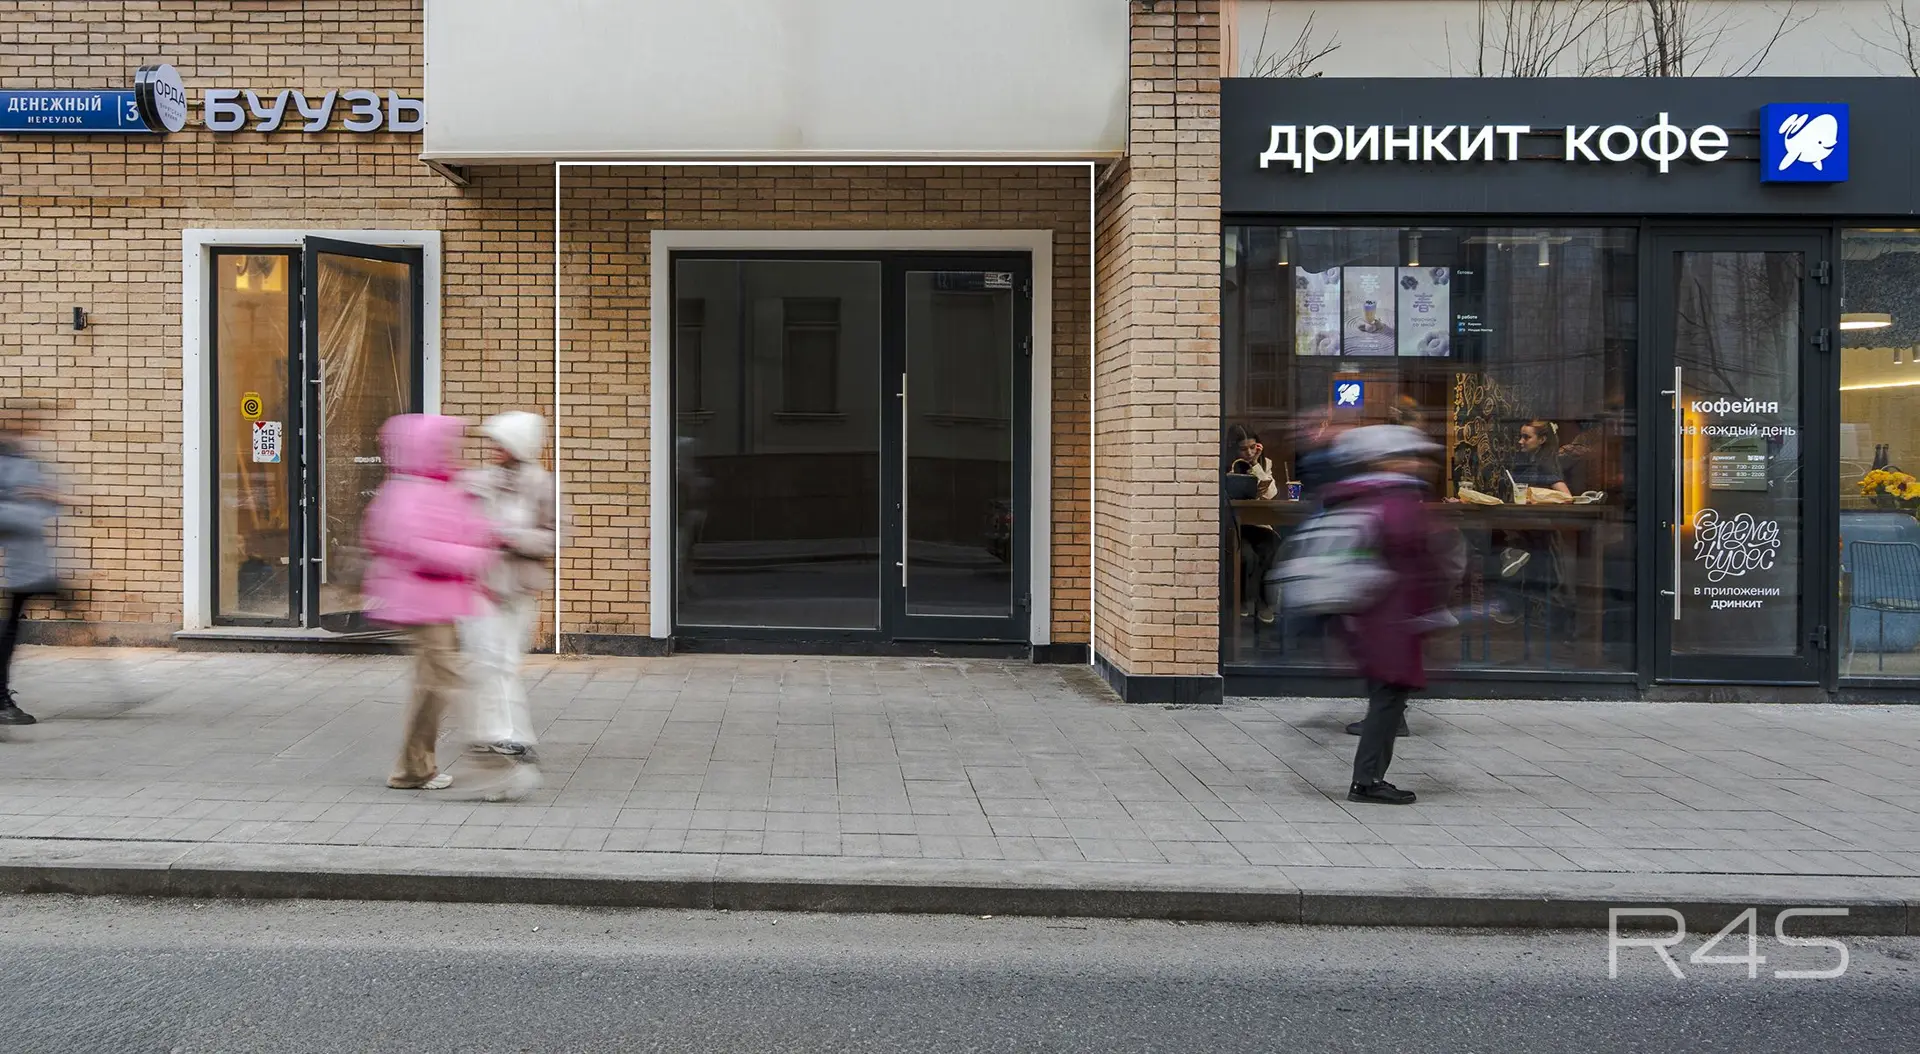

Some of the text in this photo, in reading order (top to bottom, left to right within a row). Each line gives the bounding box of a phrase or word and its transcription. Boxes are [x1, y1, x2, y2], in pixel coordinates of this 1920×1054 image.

[155, 79, 186, 108] ОРДА
[8, 95, 102, 112] ДЕНЕЖНЫЙ
[1259, 112, 1730, 173] дринкит кофе
[1691, 397, 1779, 417] кофейня
[1679, 423, 1796, 437] на каждый день
[1693, 587, 1780, 598] в приложении
[1710, 600, 1763, 610] дринкит
